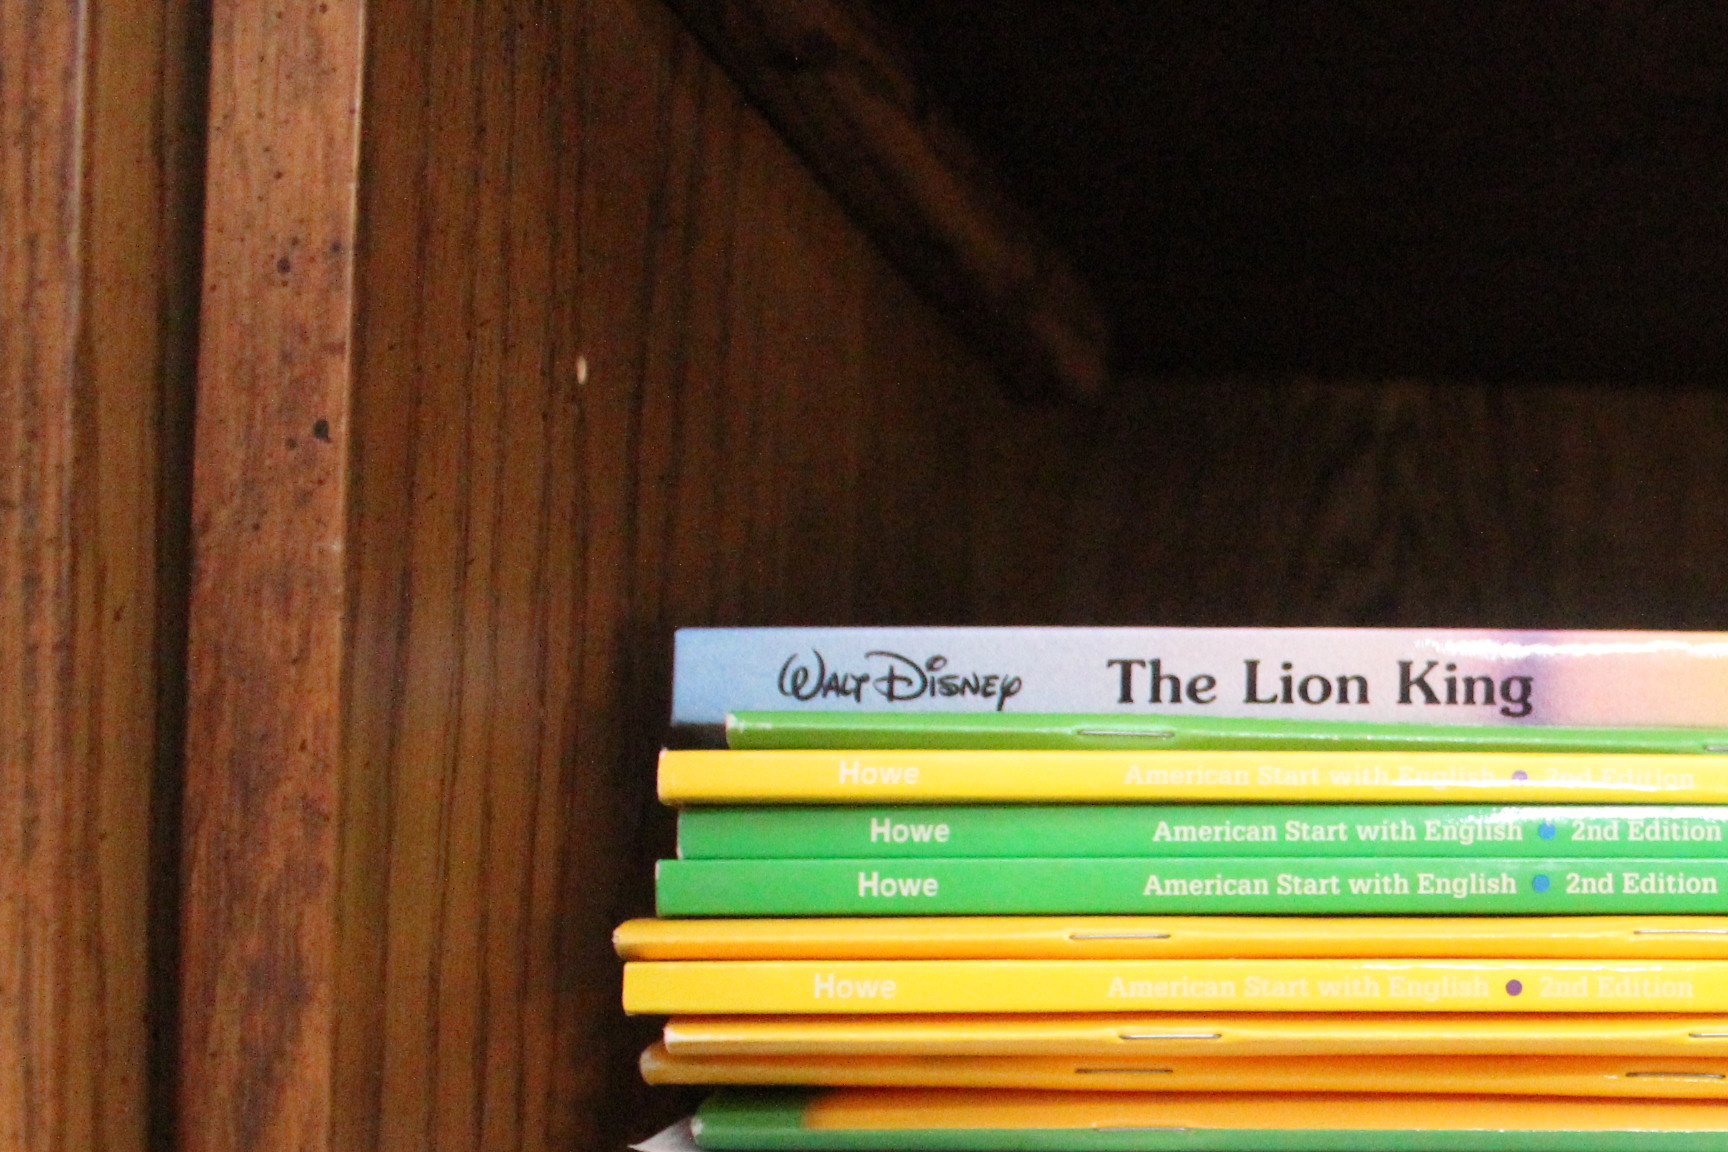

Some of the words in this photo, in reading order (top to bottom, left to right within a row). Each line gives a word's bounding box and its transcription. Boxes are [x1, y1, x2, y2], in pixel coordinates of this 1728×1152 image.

[1106, 658, 1217, 705] The
[1243, 659, 1369, 705] Lion
[1396, 659, 1535, 718] King
[839, 761, 920, 786] Howe
[1124, 765, 1250, 787] American
[1257, 766, 1324, 787] Start
[1329, 766, 1396, 788] with
[1401, 767, 1496, 792] English
[1545, 768, 1595, 789] 2nd
[1601, 769, 1695, 790] Edition
[870, 818, 951, 842] Howe
[1152, 820, 1278, 842] American
[1285, 820, 1348, 842] Start
[1356, 820, 1418, 842] with
[1424, 820, 1523, 847] English
[1571, 820, 1619, 841] 2nd
[1626, 820, 1722, 842] Edition
[858, 872, 939, 897] Howe
[1143, 873, 1269, 897] American
[1276, 873, 1341, 897] Start
[1348, 873, 1413, 897] with
[1417, 873, 1517, 900] English
[1566, 873, 1616, 896] 2nd
[1622, 873, 1718, 896] Edition
[813, 973, 897, 998] Howe
[1106, 976, 1235, 999] American
[1242, 976, 1310, 999] Start
[1316, 976, 1382, 999] with
[1387, 976, 1489, 1003] English
[1540, 976, 1590, 999] 2nd
[1596, 976, 1694, 999] Edition
